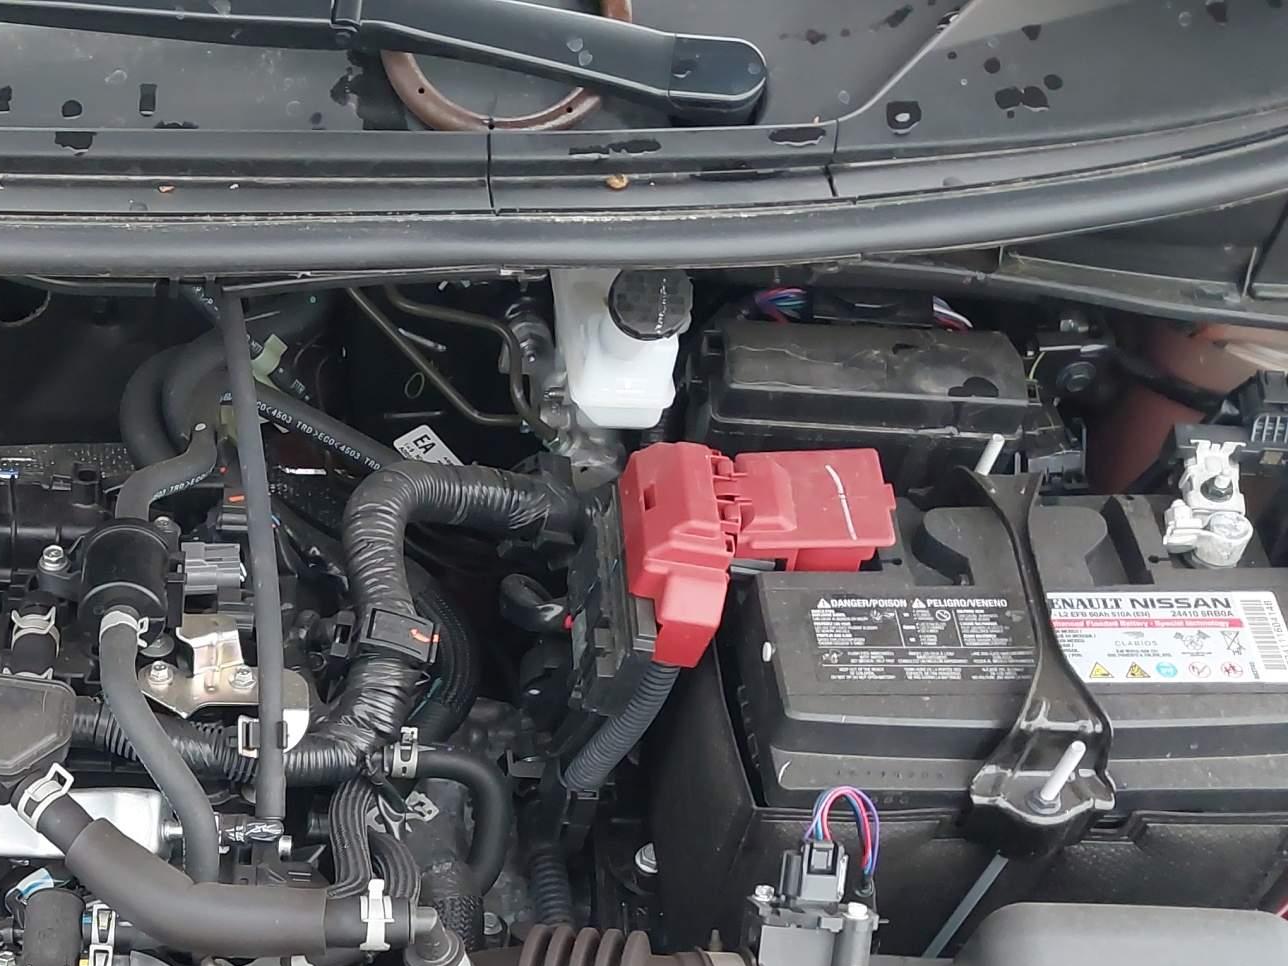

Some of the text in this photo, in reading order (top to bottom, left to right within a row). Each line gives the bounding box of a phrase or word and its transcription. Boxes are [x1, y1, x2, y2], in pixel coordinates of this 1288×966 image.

[412, 433, 437, 455] EA
[830, 598, 908, 608] DANGER/POISON
[926, 598, 1008, 608] PELIGRO/VENENO
[1047, 597, 1232, 610] ENAULT NISSAN
